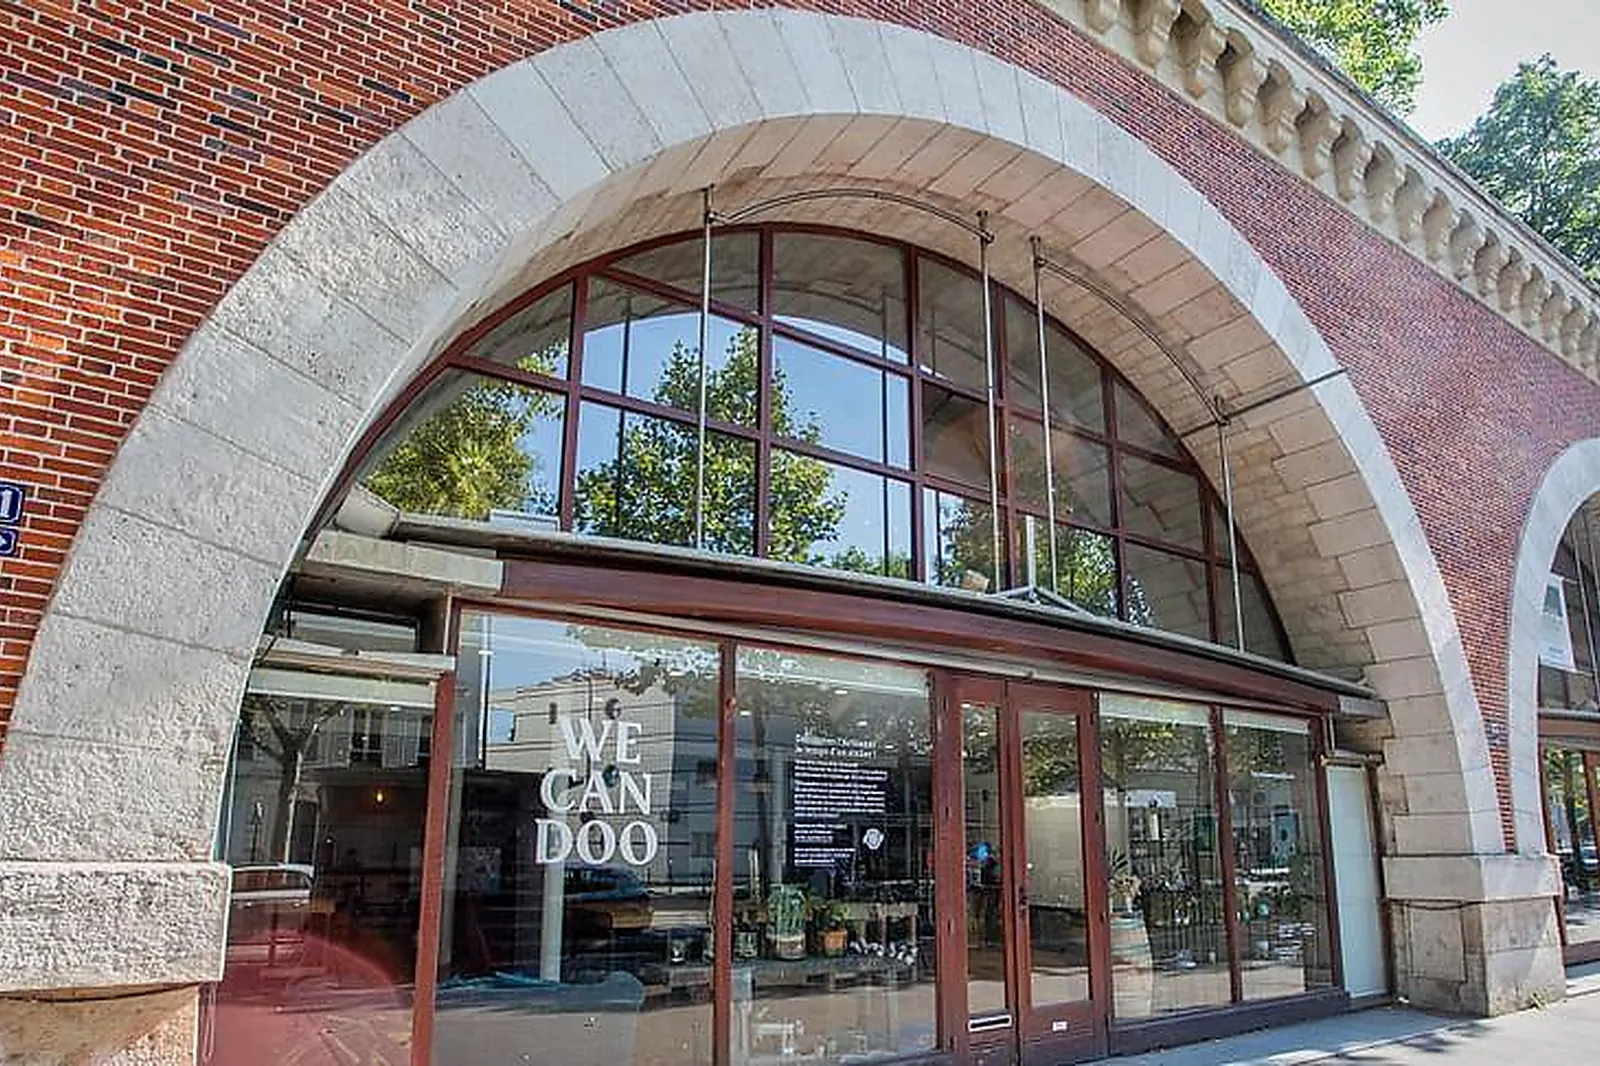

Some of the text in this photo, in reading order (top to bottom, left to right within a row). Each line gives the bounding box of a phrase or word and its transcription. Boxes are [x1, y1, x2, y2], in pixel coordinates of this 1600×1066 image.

[560, 717, 642, 764] WE
[540, 769, 652, 815] CAN
[534, 818, 658, 866] DOO
